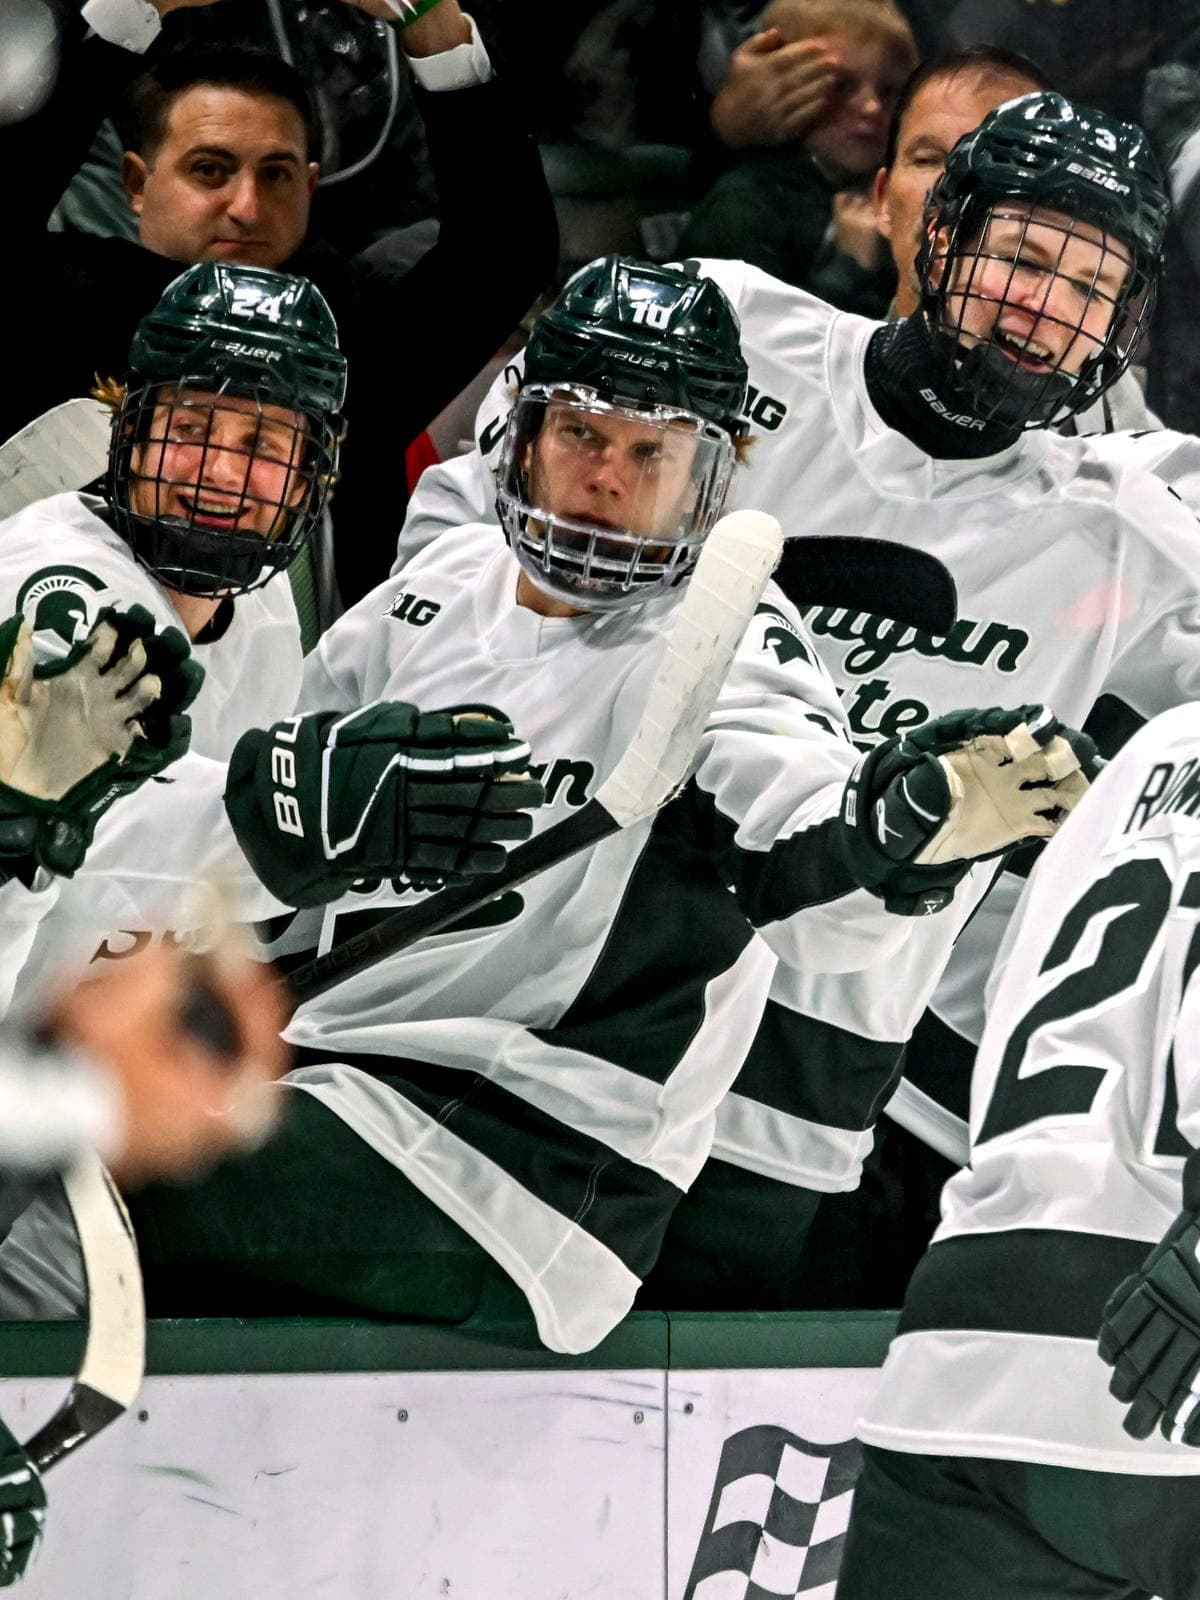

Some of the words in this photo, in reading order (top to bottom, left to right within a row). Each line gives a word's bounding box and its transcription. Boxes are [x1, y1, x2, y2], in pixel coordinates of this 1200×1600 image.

[1095, 128, 1117, 152] 3
[231, 288, 281, 324] 24
[630, 300, 672, 330] 10
